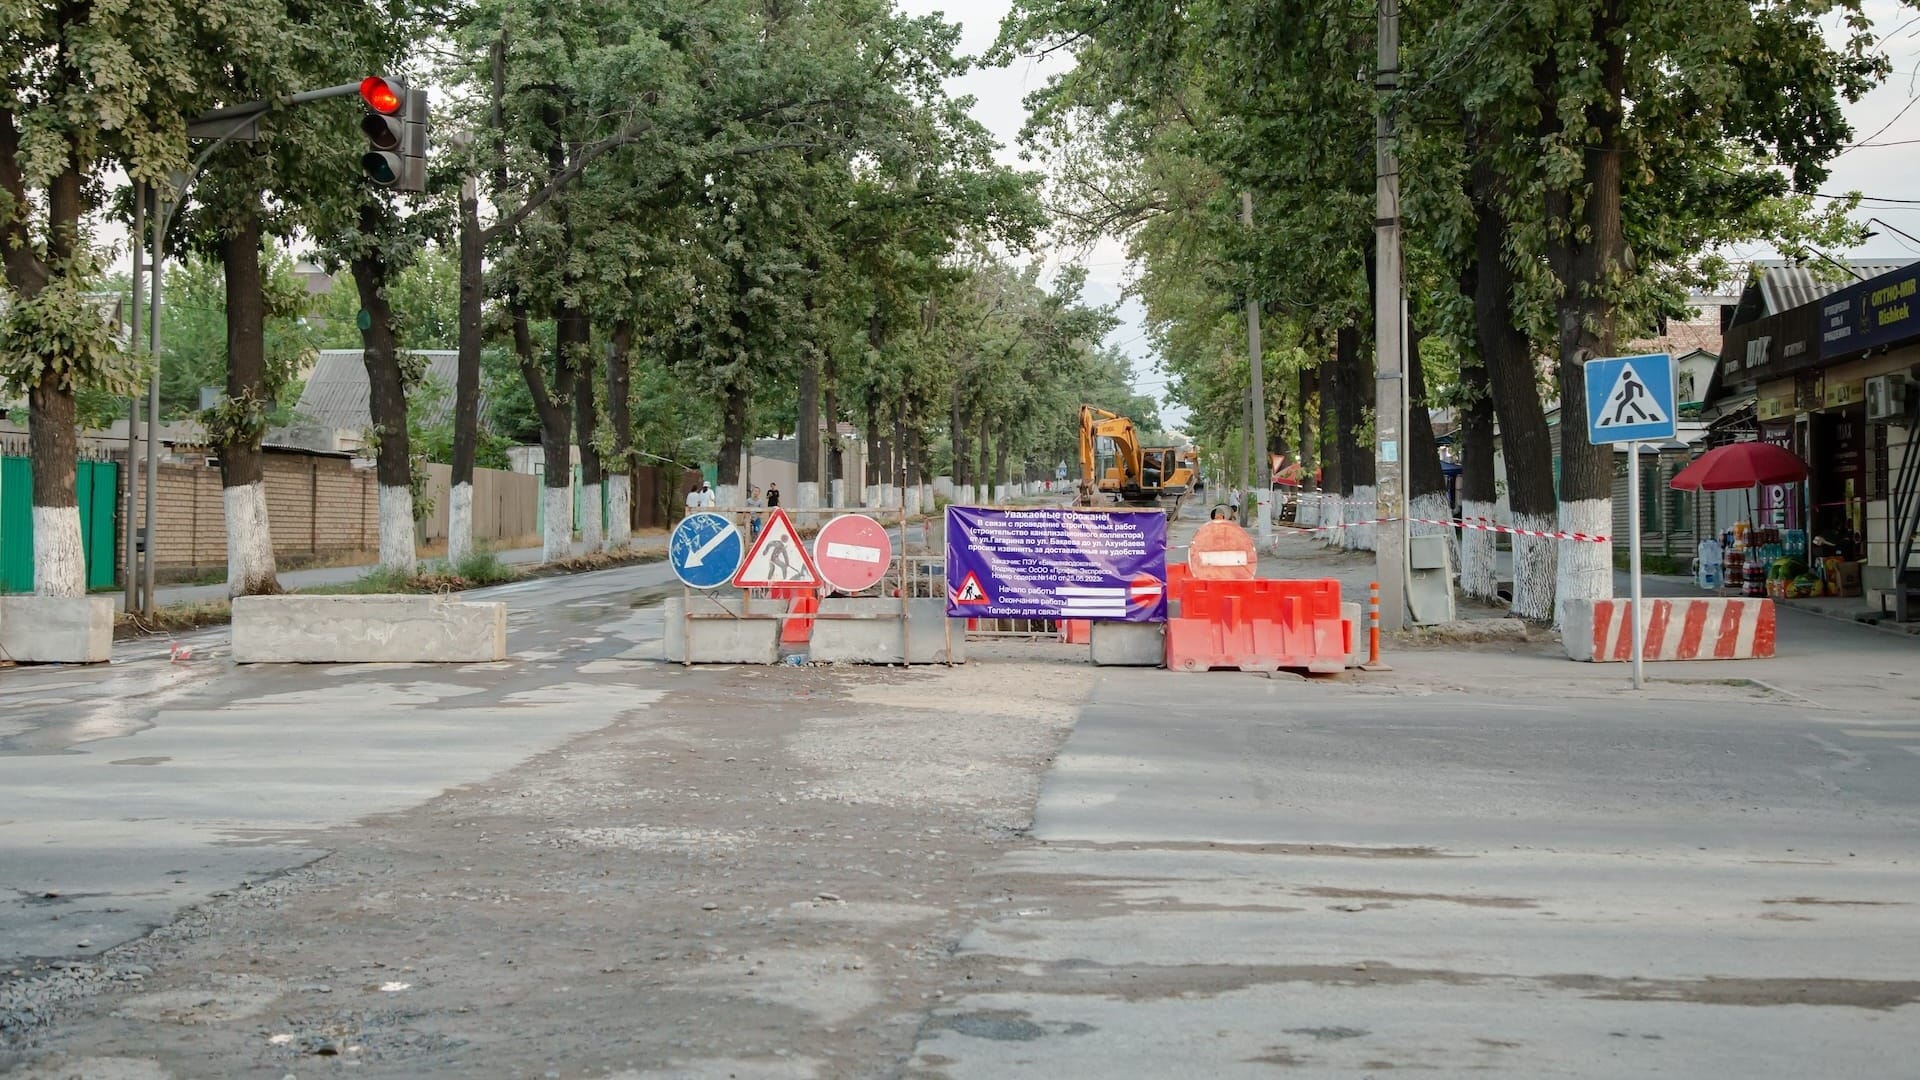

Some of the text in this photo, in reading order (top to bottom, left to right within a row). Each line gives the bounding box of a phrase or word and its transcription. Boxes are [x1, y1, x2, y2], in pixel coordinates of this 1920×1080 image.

[1871, 277, 1917, 308] ORTHO-MIR
[1878, 301, 1910, 327] Bishkek
[1005, 510, 1110, 521] Уважаемые горожане!
[1014, 521, 1060, 529] проведение
[1061, 522, 1113, 530] строительных
[1115, 523, 1137, 531] работ
[970, 527, 1145, 540] (строительство канализационного коллектора)
[1037, 538, 1048, 546] ул.
[1050, 538, 1080, 546] Бакаева
[1105, 540, 1145, 548] Ахунбаева
[968, 544, 996, 552] просим
[1044, 547, 1098, 555] доставленные
[1110, 548, 1147, 556] удобства.
[992, 572, 1012, 580] Номер
[998, 585, 1055, 595] Начало работы
[998, 596, 1067, 606] Окончание работы
[987, 606, 1021, 615] Телефон
[1022, 608, 1037, 616] для
